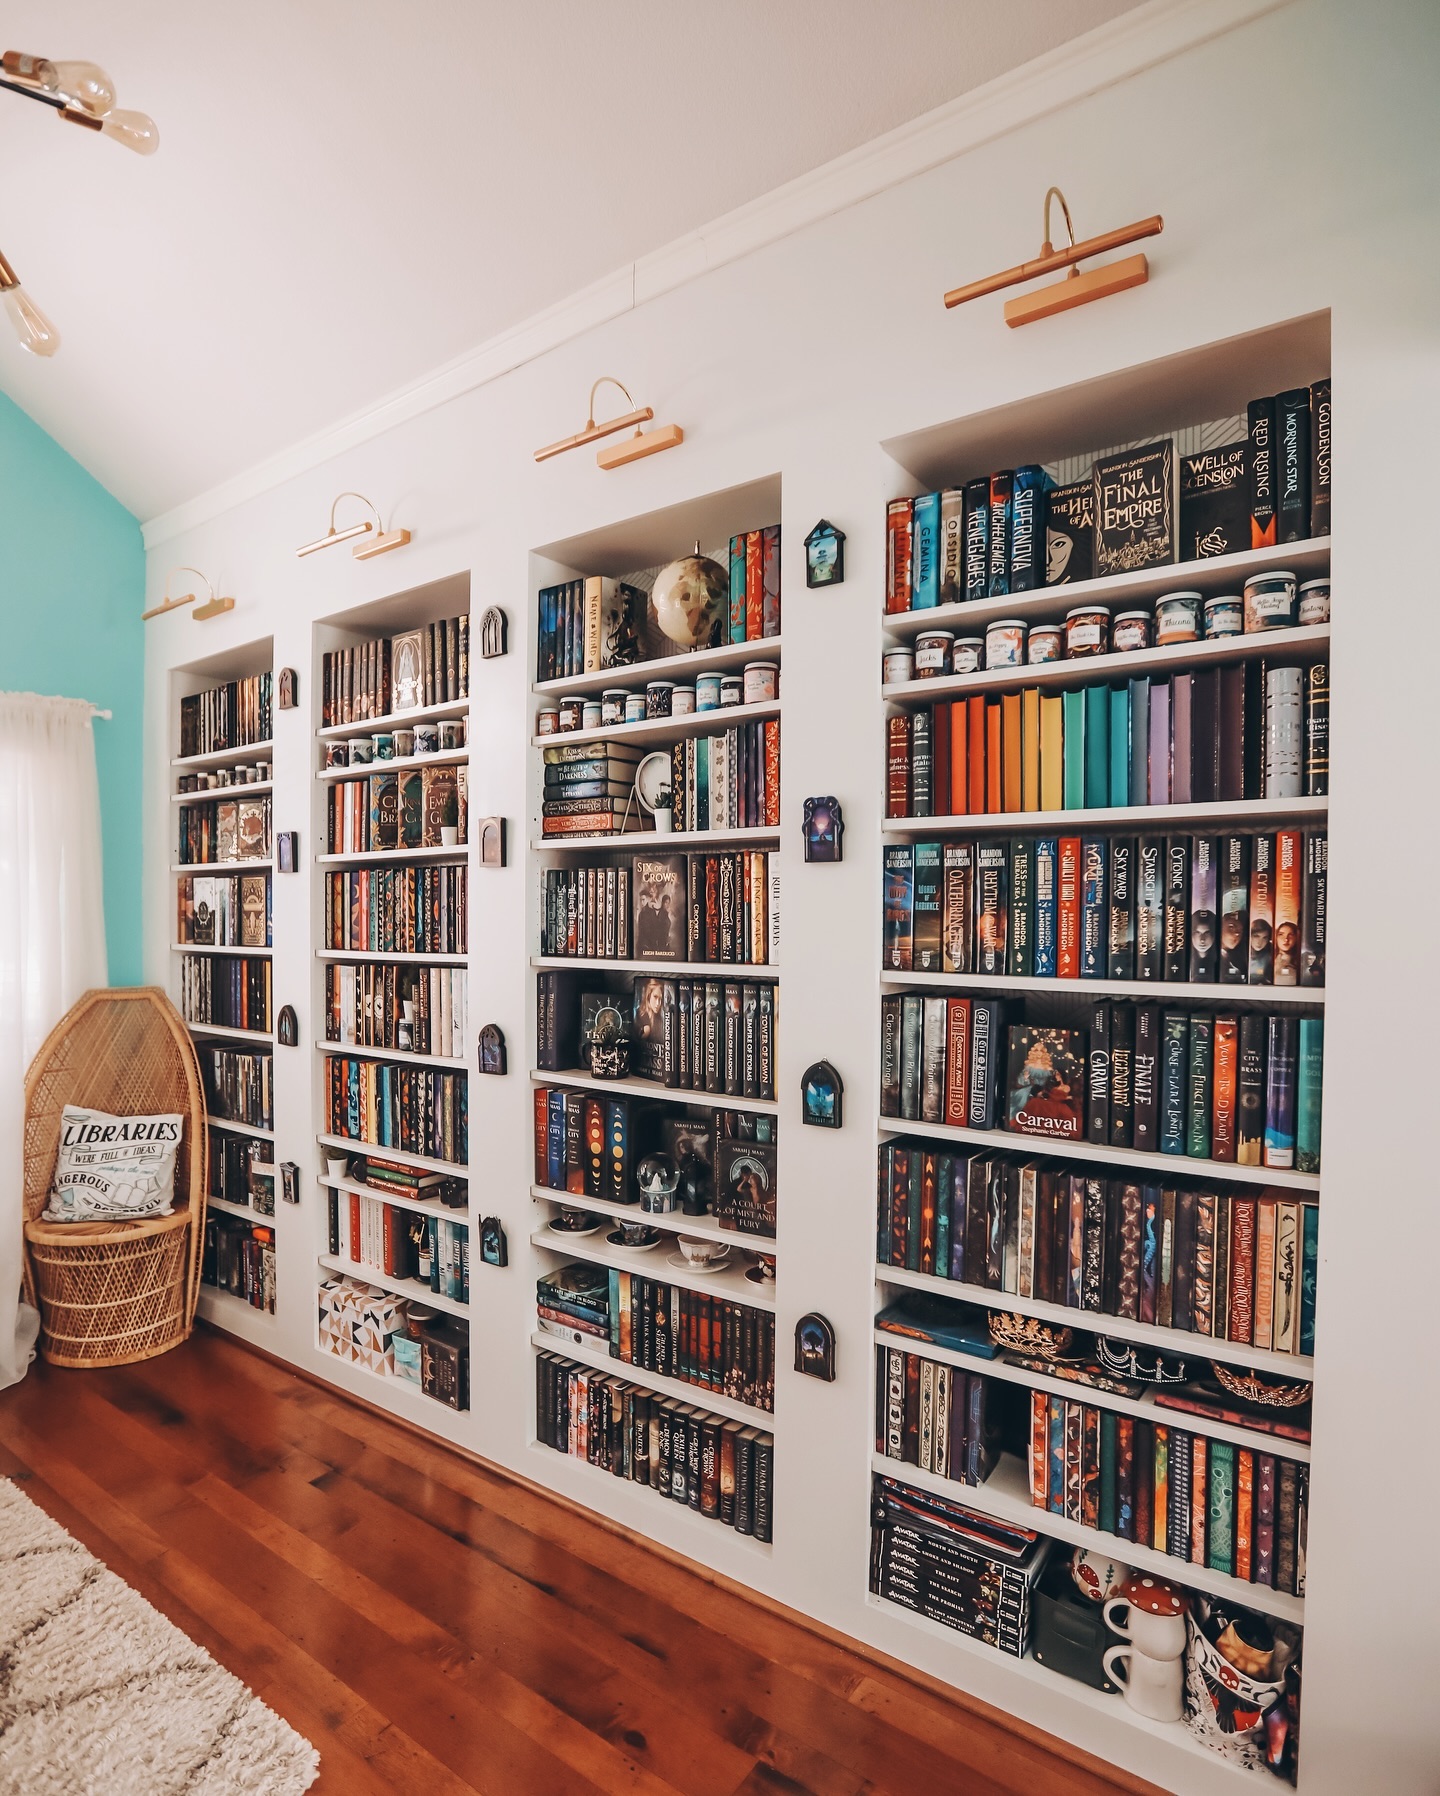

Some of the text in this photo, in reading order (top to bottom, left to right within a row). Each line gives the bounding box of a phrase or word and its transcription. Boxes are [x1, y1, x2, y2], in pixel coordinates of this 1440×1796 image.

[1316, 402, 1331, 461] GOLDEN
[1102, 452, 1162, 475] BRANDON SANDERSON
[1187, 450, 1244, 474] WELL OF
[1252, 418, 1270, 497] RED RISING
[1284, 413, 1298, 498] MORNING STAR
[1119, 467, 1144, 485] THE
[1318, 458, 1331, 486] SON
[1050, 486, 1080, 499] BRANDON
[1103, 475, 1162, 510] FINAL
[1051, 503, 1068, 514] THE
[1103, 497, 1163, 531] EMPIRE
[991, 502, 1006, 575] ARCHENEMIES
[1012, 489, 1034, 572] SUPERNOVA
[920, 527, 931, 583] GEMINA
[947, 520, 957, 578] OBSIDIO
[967, 510, 986, 589] RENEGADES
[589, 595, 598, 621] NAME
[559, 771, 588, 781] DARKNESS
[563, 763, 583, 773] BEAUTY
[637, 862, 653, 872] SIX
[978, 858, 1006, 867] SANDERSON
[1020, 853, 1028, 880] TRESS
[1083, 847, 1101, 882] YUMI
[1114, 848, 1129, 900] SKYWARD
[1142, 847, 1158, 902] STARSIGHT
[1170, 847, 1186, 889] CYTONIC
[642, 872, 677, 882] CROWS
[753, 877, 762, 903] KING
[918, 885, 937, 894] WORDS
[1061, 855, 1076, 901] SUNLIT MAN
[915, 902, 940, 911] RADIANCE
[949, 870, 965, 949] OATHBRINGER
[984, 871, 998, 948] RHYTHM WAR
[1316, 879, 1325, 915] SKYWARD
[1111, 906, 1120, 955] SANDERSON
[1139, 906, 1148, 956] SANDERSON
[1176, 910, 1185, 951] BRANDON
[709, 1042, 715, 1053] OF
[762, 1048, 768, 1058] OF
[884, 1013, 895, 1088] Clockwork Angel
[906, 1061, 915, 1088] Prince
[927, 1063, 937, 1098] Princess
[1090, 1050, 1110, 1101] CARAVAL
[1111, 1049, 1131, 1107] LEGENDARY
[1134, 1053, 1155, 1105] FINALE
[1168, 1040, 1182, 1106] CURSE DARK
[1191, 1040, 1208, 1106] HEART FIERCE
[1215, 1042, 1231, 1144] VOW DEADLY
[63, 1122, 178, 1147] LIBRARIES
[1015, 1111, 1078, 1132] Caraval
[1021, 1125, 1050, 1135] Stephanie
[1165, 1110, 1182, 1140] LONELY
[74, 1146, 156, 1164] WERE FULL IDEAS
[58, 1174, 110, 1193] NGEROUS
[724, 1207, 775, 1222] OF MIST AND
[738, 1200, 767, 1212] COURT
[739, 1219, 760, 1229] FURY
[582, 1297, 597, 1306] BLOOD
[758, 1453, 767, 1526] STORMCASTER
[891, 1536, 920, 1553] AVATAR
[893, 1525, 923, 1542] AVATAR
[890, 1549, 920, 1567] AVATAR
[928, 1540, 946, 1552] NORTH
[960, 1552, 979, 1564] SOUTH
[888, 1561, 918, 1579] AVATAR
[935, 1569, 960, 1583] THE RIFT
[940, 1556, 951, 1565] AND
[952, 1562, 975, 1575] SHADOW
[889, 1574, 919, 1593] AVATAR
[941, 1585, 962, 1598] SEARCH
[888, 1590, 918, 1608] AVATAR
[940, 1598, 964, 1612] PROMISE
